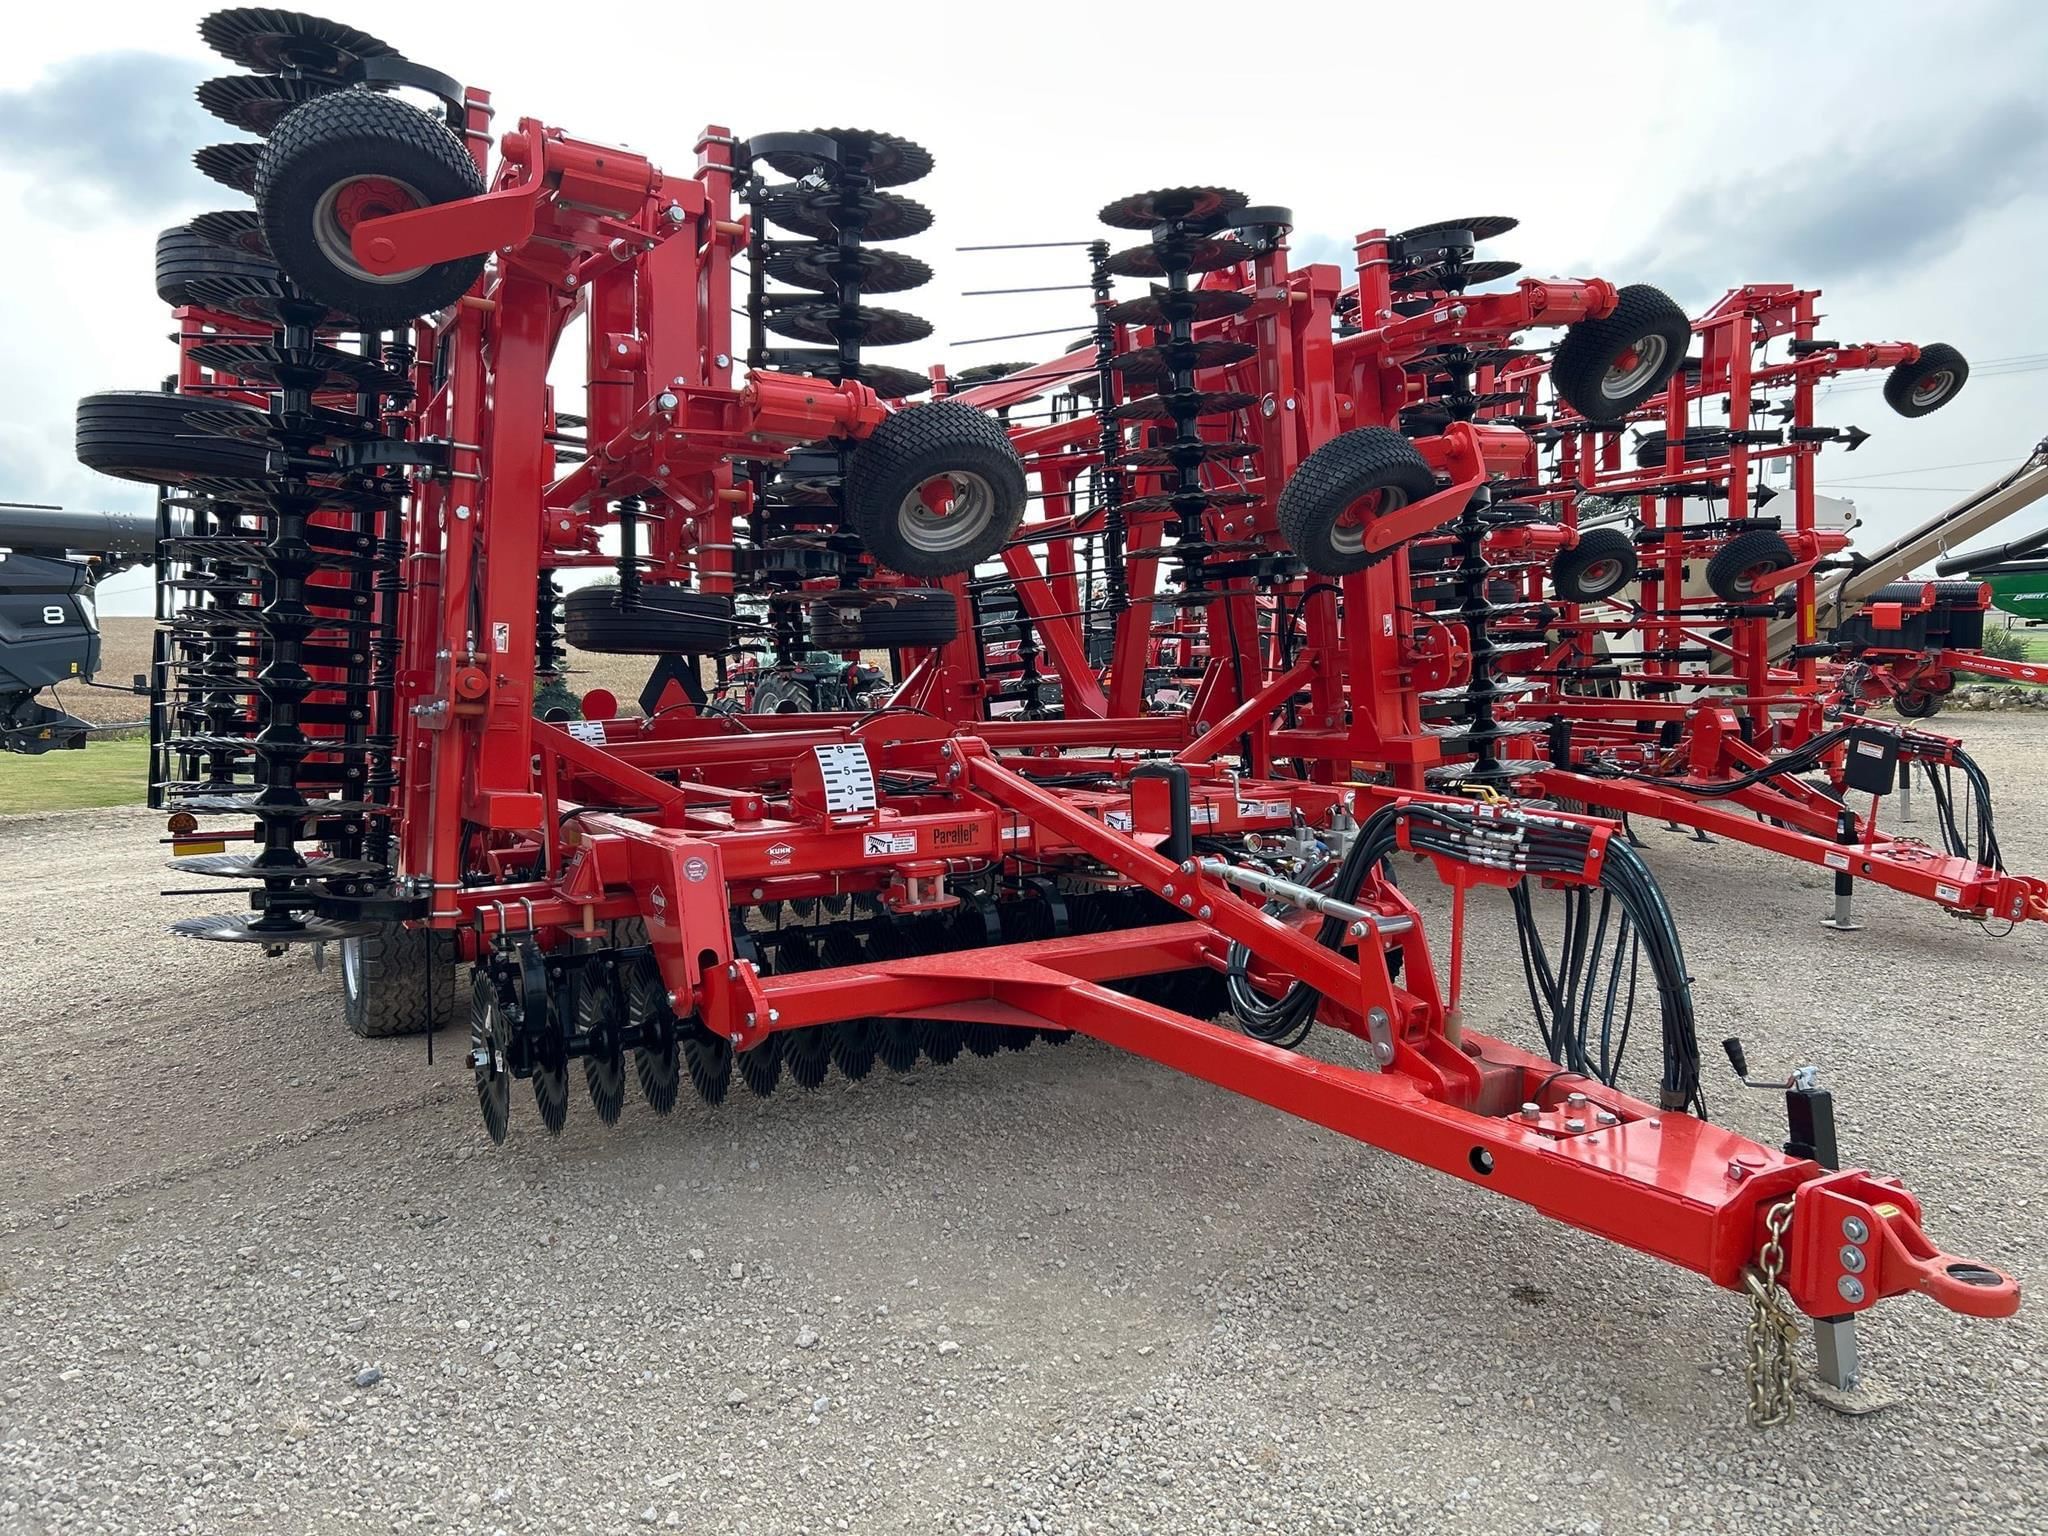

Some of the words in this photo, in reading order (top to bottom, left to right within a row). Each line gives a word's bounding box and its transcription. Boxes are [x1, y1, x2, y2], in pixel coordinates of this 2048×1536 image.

[43, 606, 65, 624] 8
[836, 745, 844, 754] 8
[843, 766, 851, 776] 5
[846, 785, 854, 795] 3
